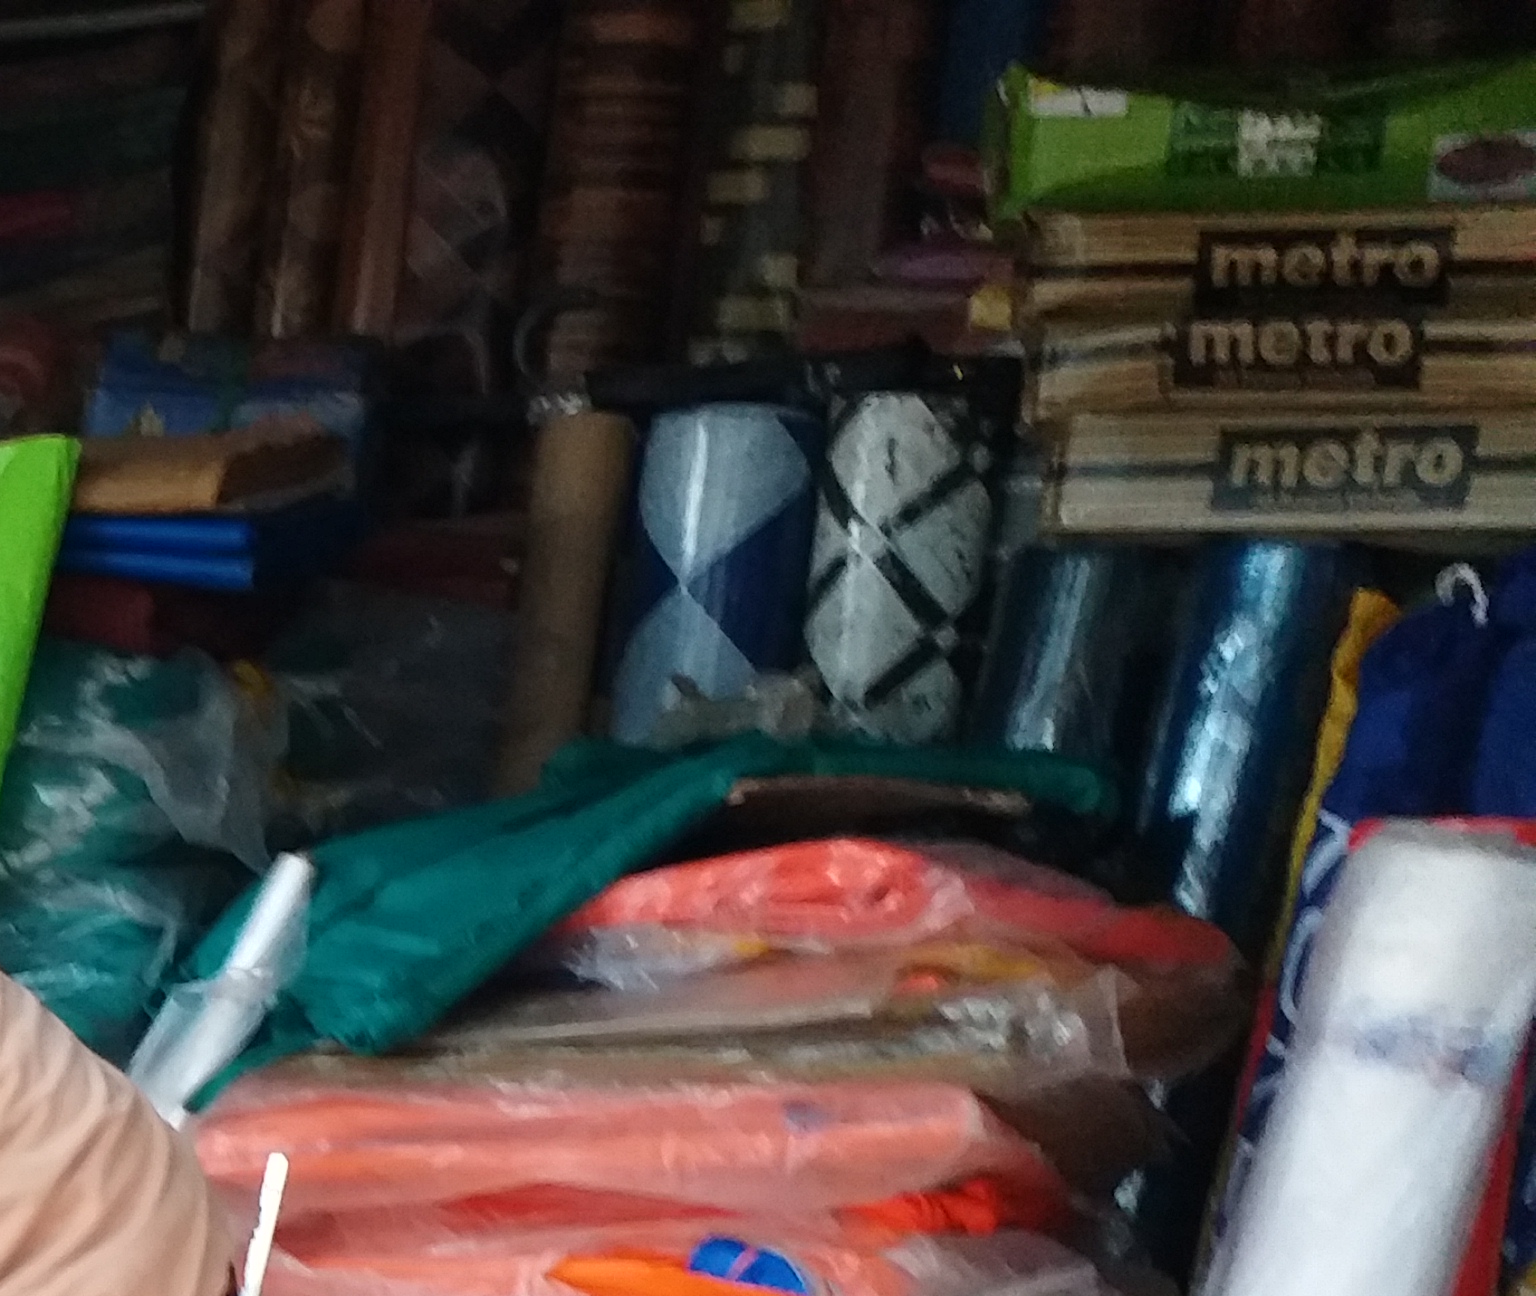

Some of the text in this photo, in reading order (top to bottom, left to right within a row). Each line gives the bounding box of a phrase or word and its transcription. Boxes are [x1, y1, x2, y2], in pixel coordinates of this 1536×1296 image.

[1210, 234, 1442, 289] metro
[1188, 318, 1414, 367] metro
[1230, 430, 1464, 488] metro
